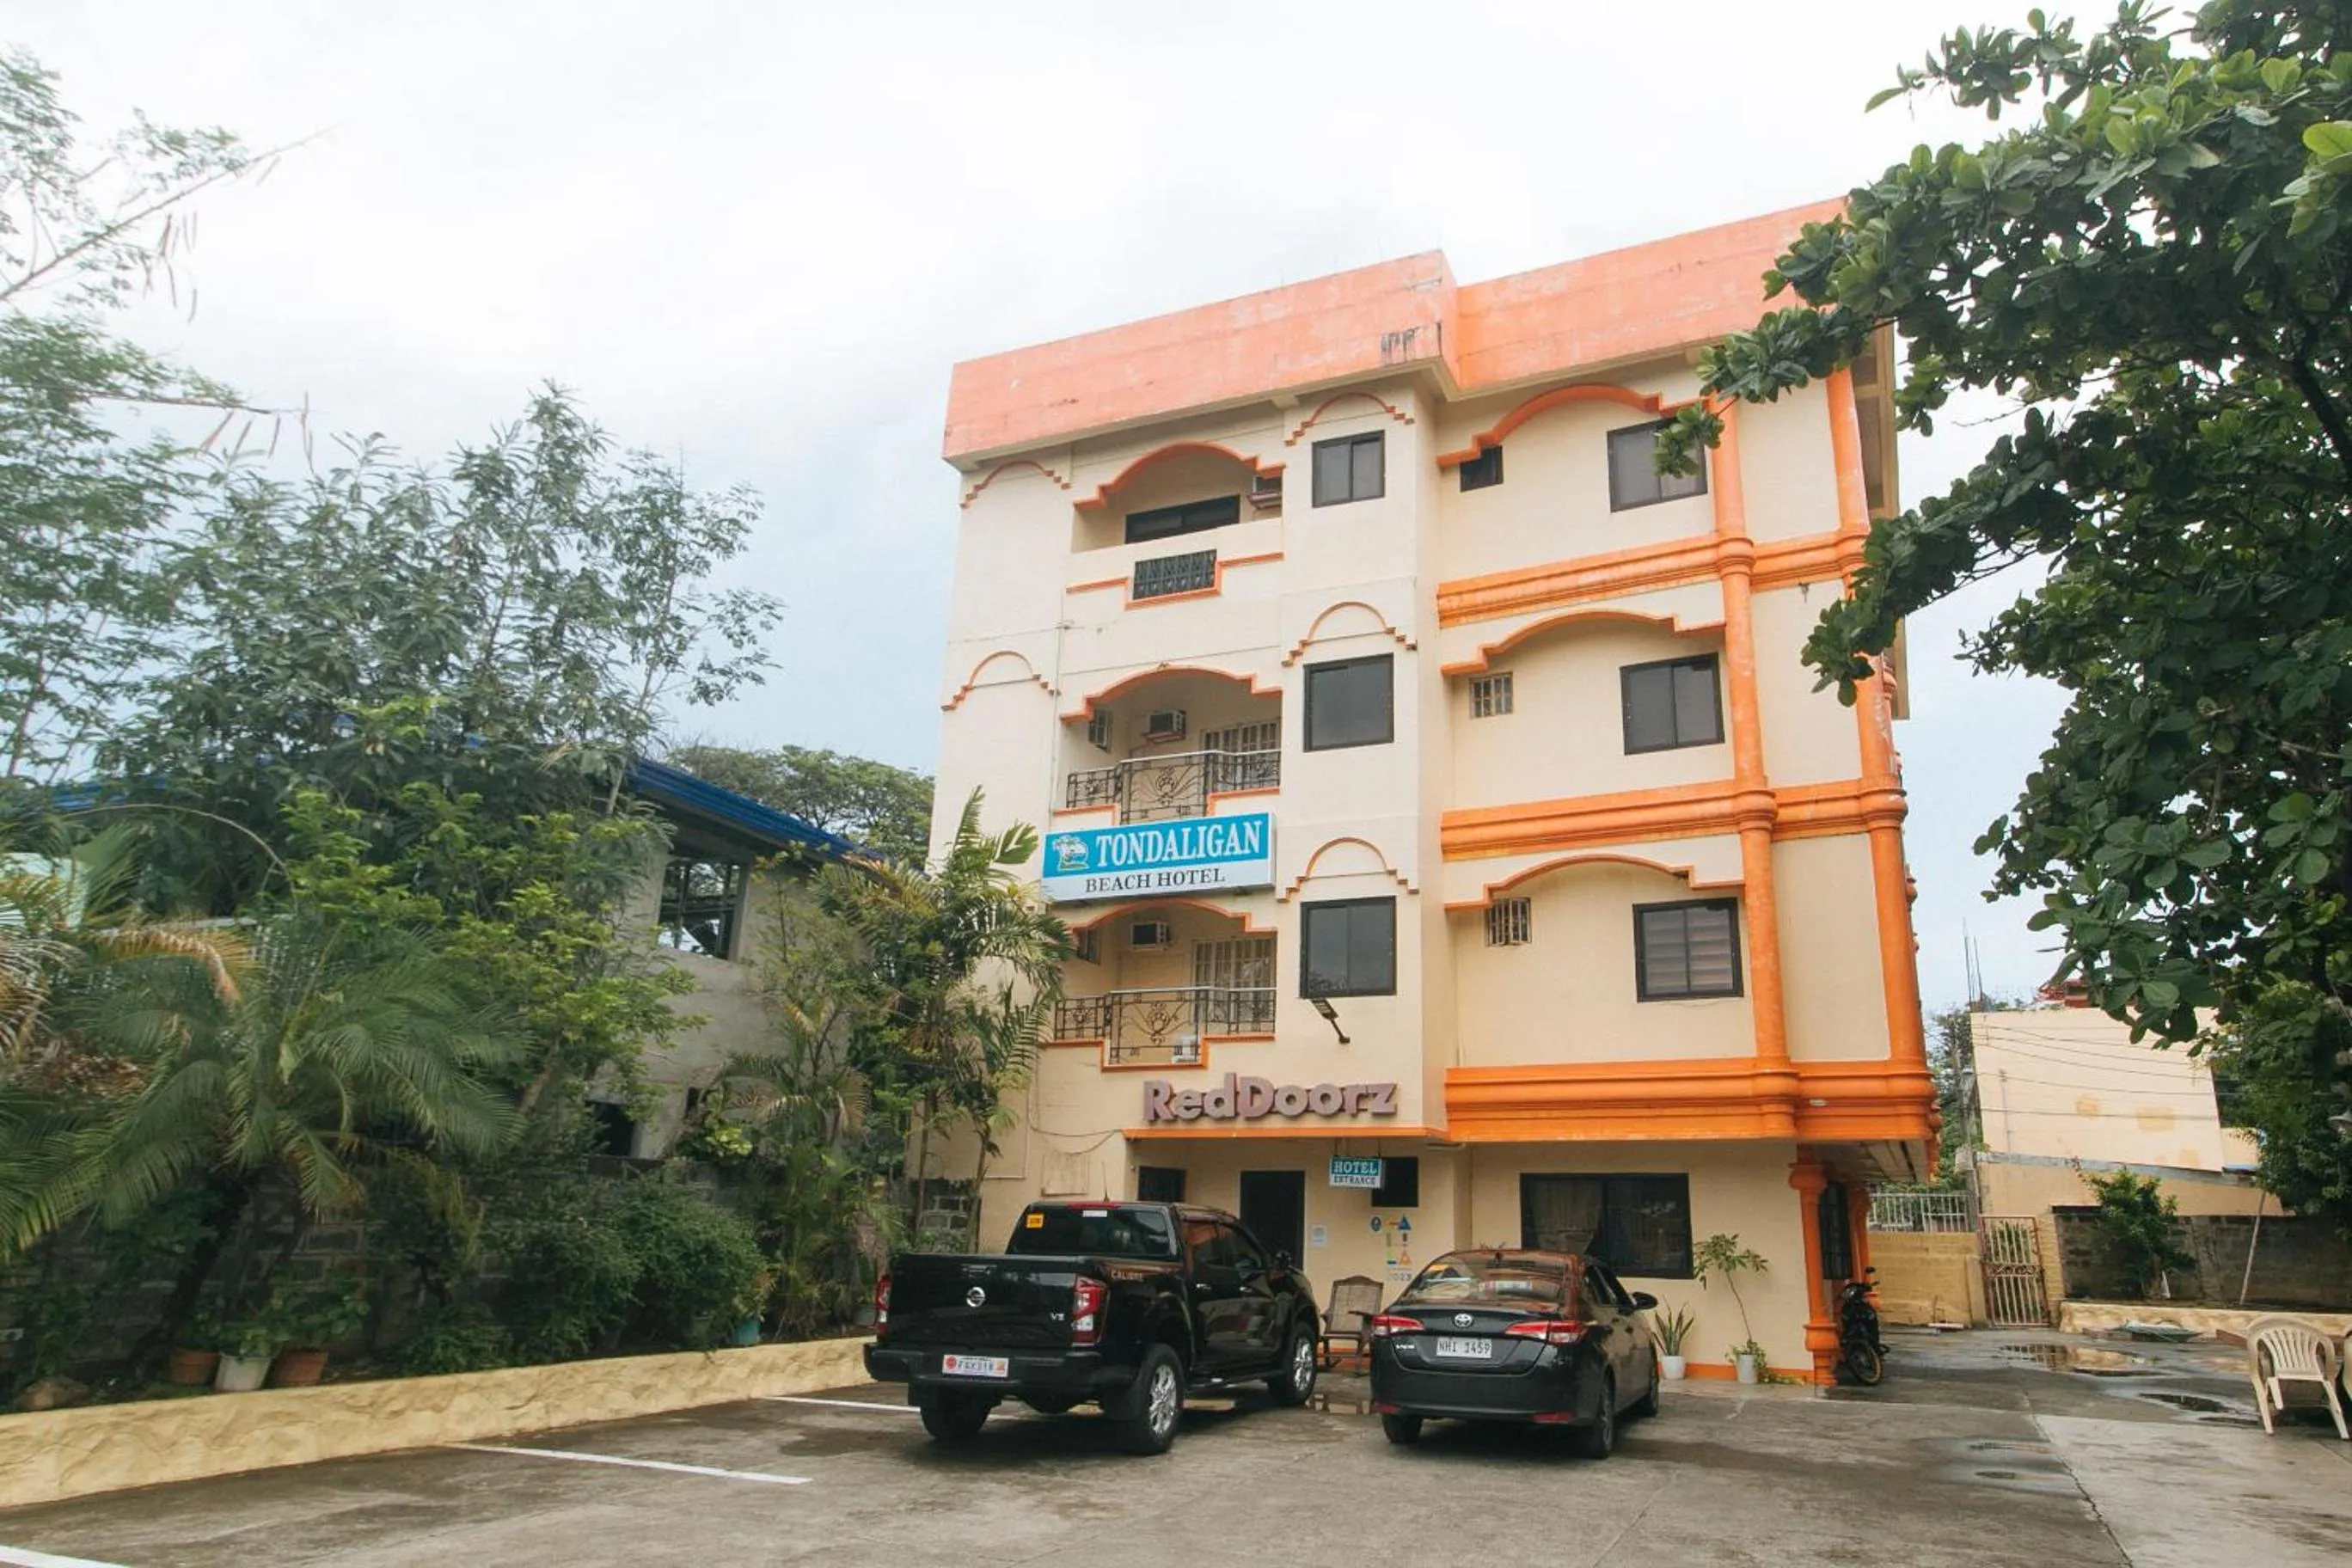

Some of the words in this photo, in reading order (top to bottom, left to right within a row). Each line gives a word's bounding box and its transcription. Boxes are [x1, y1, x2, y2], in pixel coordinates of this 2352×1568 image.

[1096, 820, 1263, 867] TONDALIGAN
[1086, 871, 1150, 893] BEACH
[1157, 867, 1226, 887] HOTEL
[1143, 1073, 1399, 1123] RedDoorz
[1333, 1161, 1378, 1173] HOTEL
